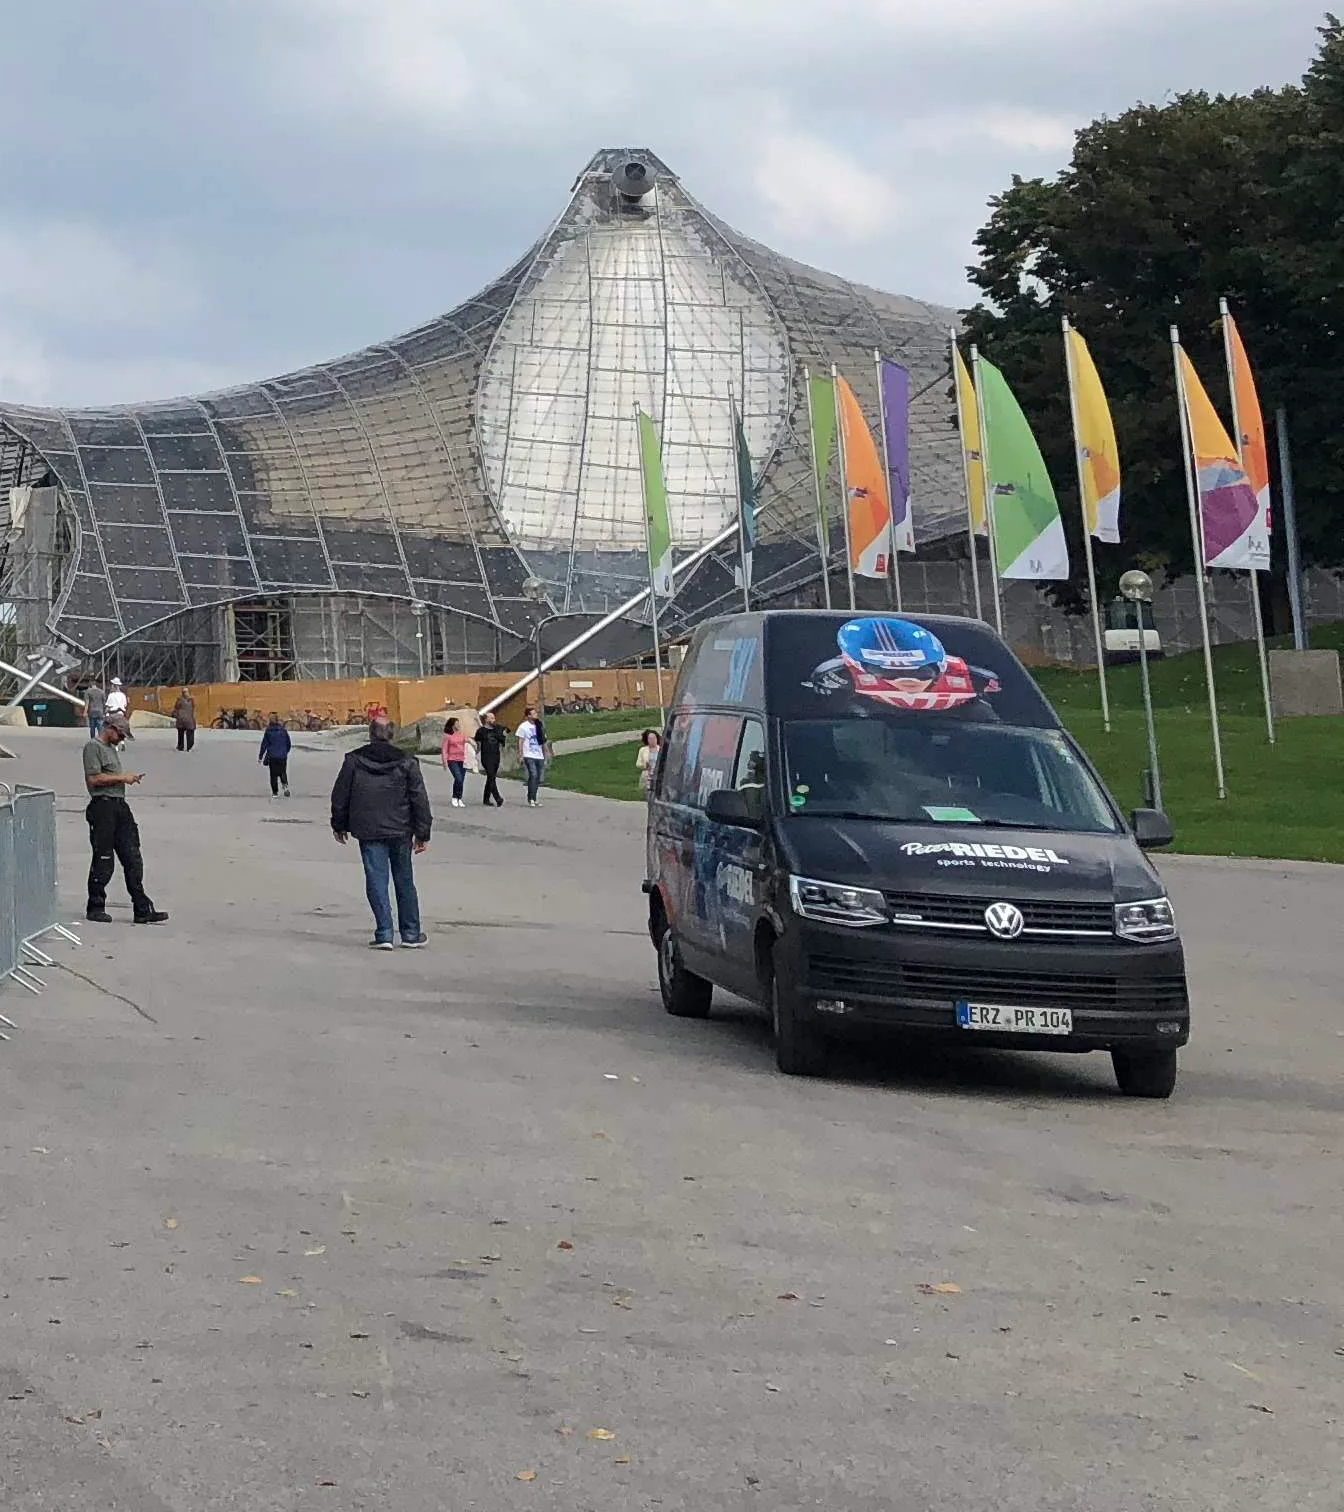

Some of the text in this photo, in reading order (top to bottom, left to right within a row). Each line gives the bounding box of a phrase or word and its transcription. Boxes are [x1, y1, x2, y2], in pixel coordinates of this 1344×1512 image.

[900, 842, 1070, 864] Peter RIEDEL
[937, 859, 1051, 873] sports technology
[985, 902, 1023, 938] VW
[969, 1006, 1070, 1028] ERZ PR 104
